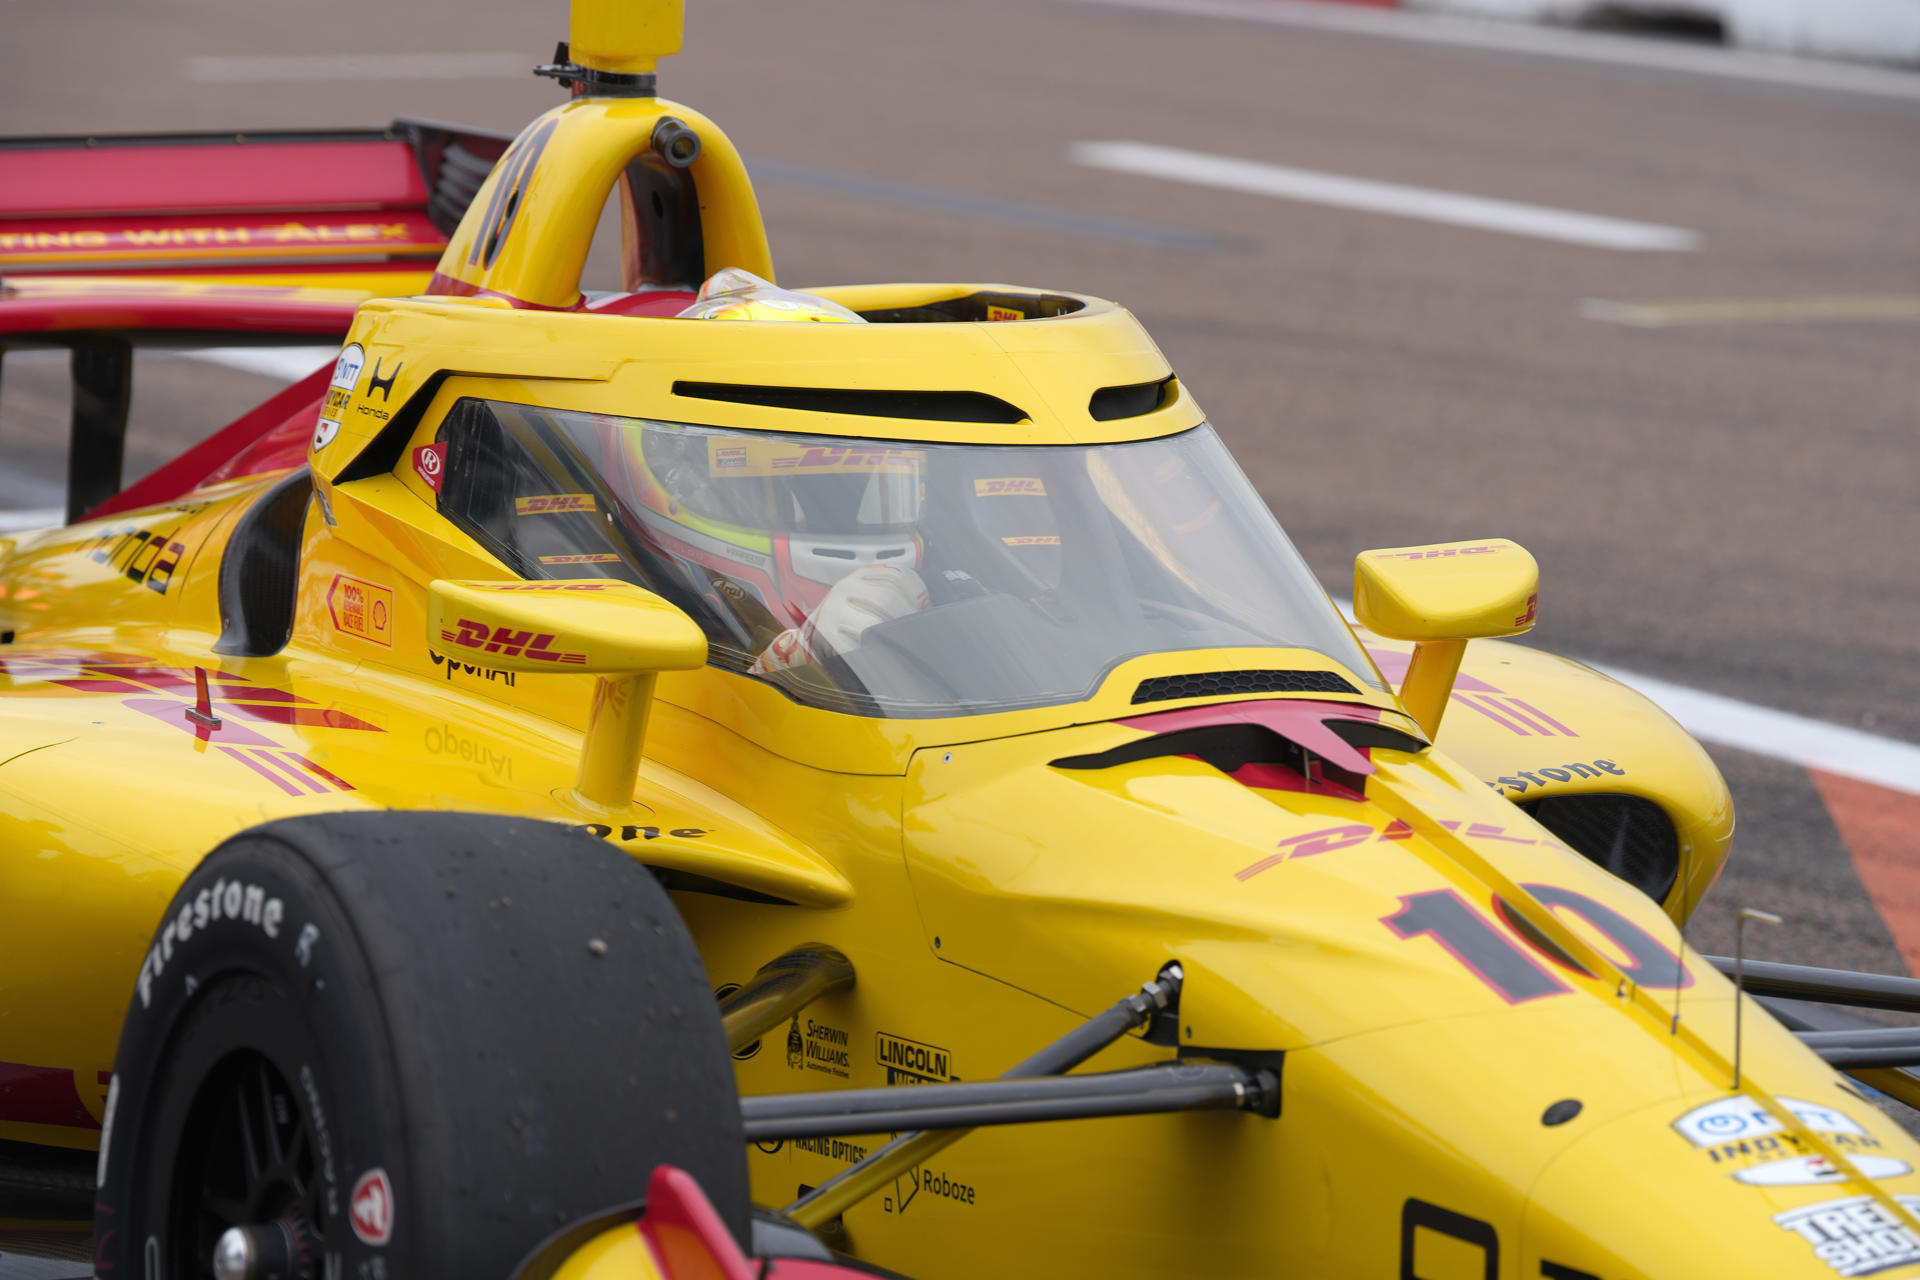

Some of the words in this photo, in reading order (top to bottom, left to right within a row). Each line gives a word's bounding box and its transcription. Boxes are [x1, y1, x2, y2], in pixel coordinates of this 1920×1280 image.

[124, 226, 250, 247] WITH
[272, 222, 409, 243] ALEX
[356, 403, 391, 421] Honda
[525, 496, 586, 512] DHL
[452, 618, 563, 662] DHL
[138, 878, 284, 1009] Firestone
[1379, 882, 1695, 1007] 10
[806, 1019, 848, 1046] SHERWIN
[879, 1037, 947, 1078] LINCOLN
[1707, 1131, 1884, 1163] INDYAR
[923, 1168, 975, 1206] Roboze
